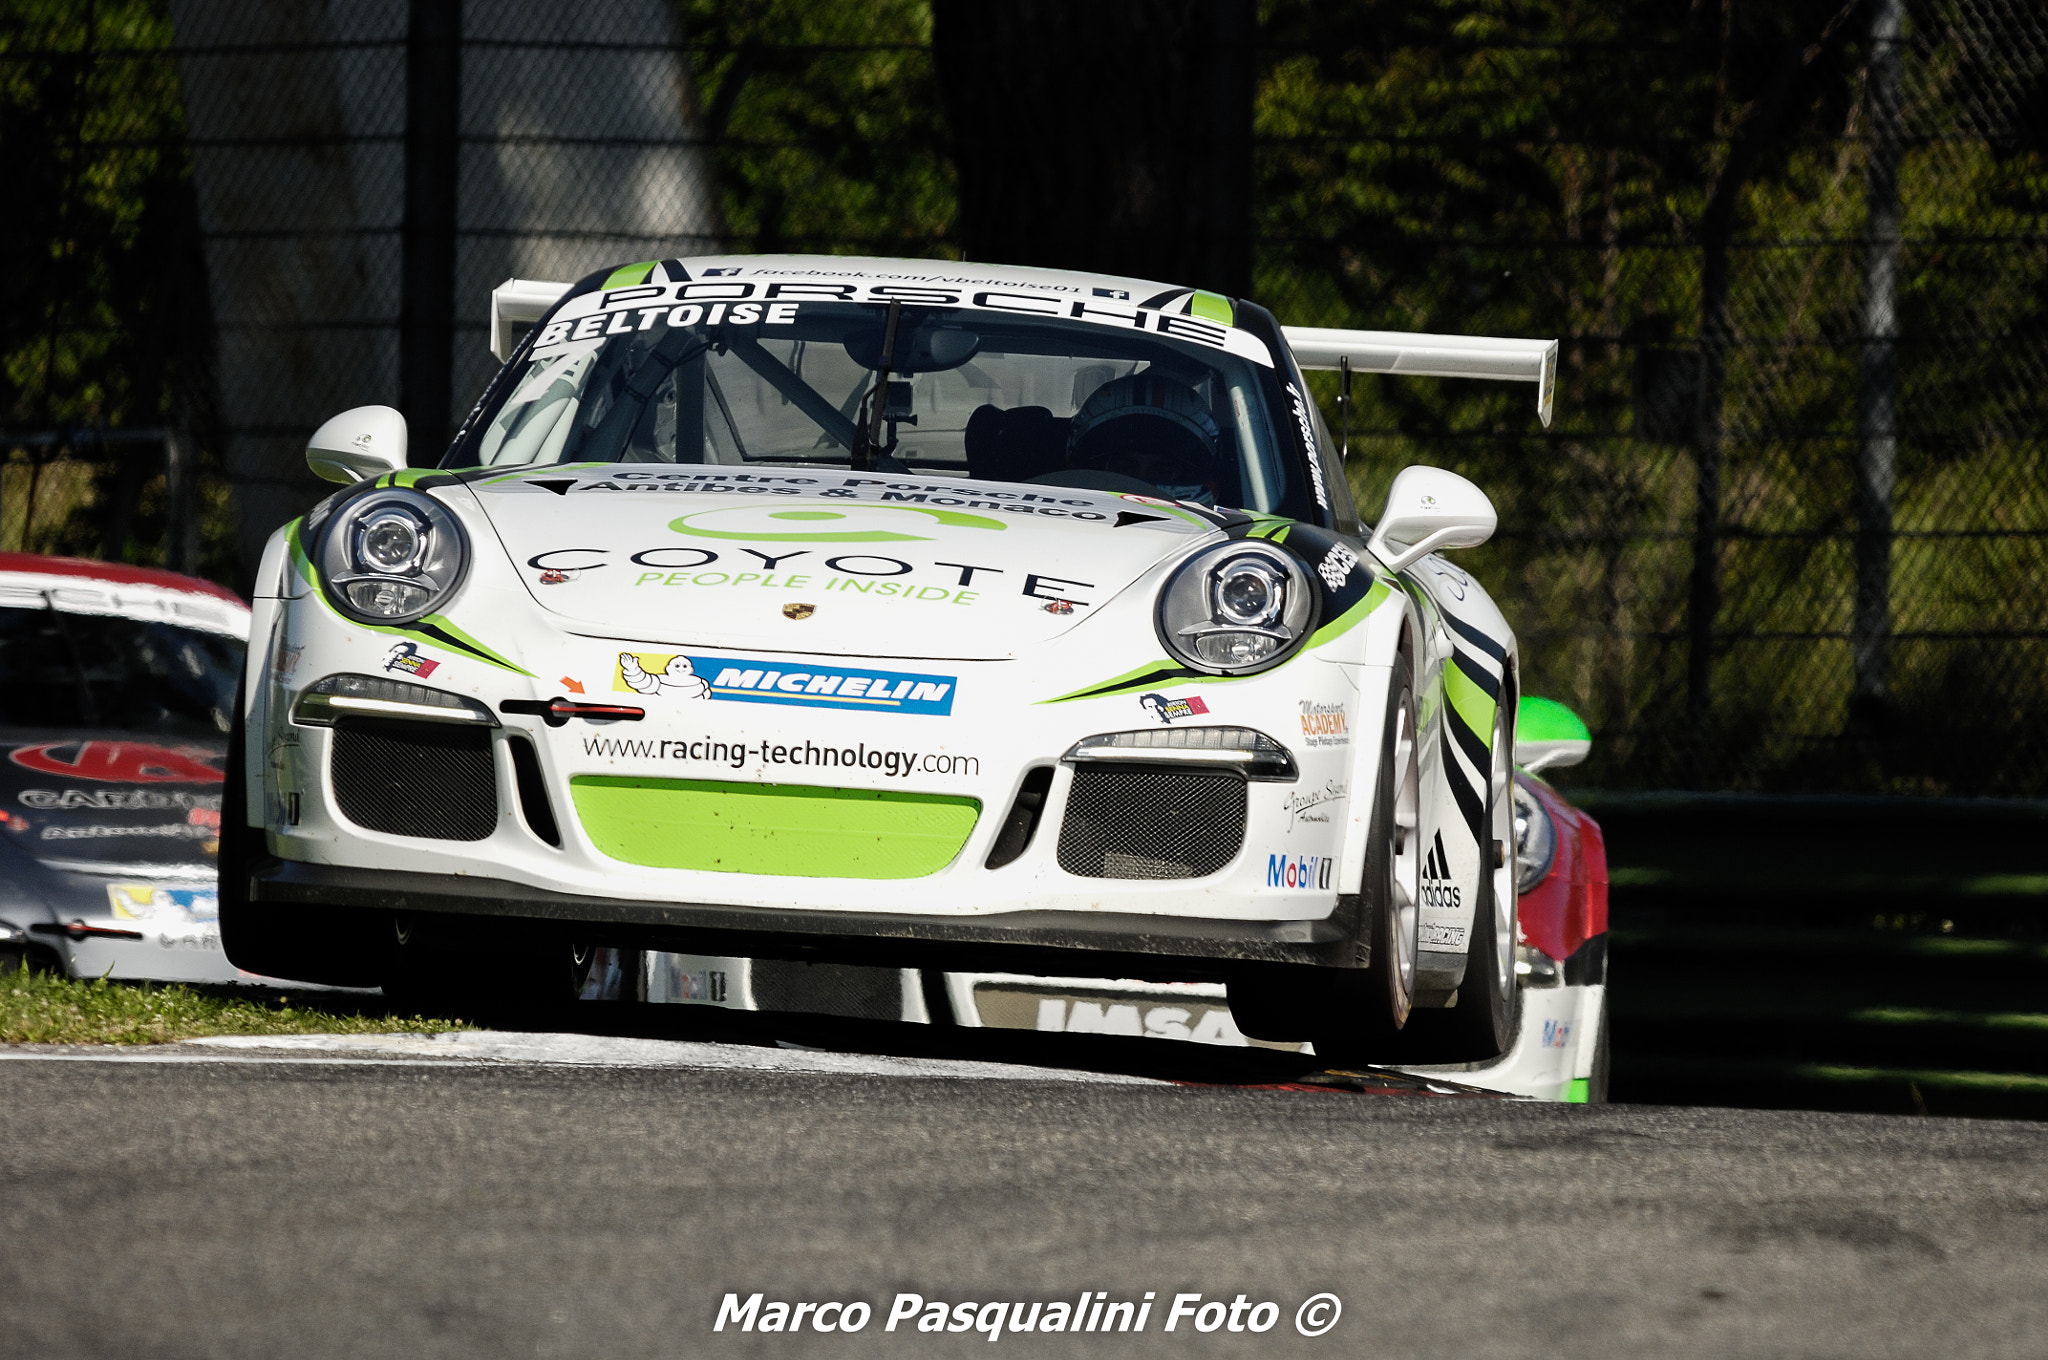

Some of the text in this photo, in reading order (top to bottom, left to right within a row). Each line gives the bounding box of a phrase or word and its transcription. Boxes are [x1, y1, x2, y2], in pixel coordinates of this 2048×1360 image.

[533, 303, 799, 348] BELTOISE
[599, 282, 1227, 348] PORSCHE
[578, 481, 1107, 520] Antibes & Monaco
[612, 472, 1095, 507] Centre Porsche
[527, 546, 1095, 607] COYOTE
[634, 571, 979, 606] PEOPLE INSIDE
[713, 667, 950, 702] MICHELIN
[583, 735, 979, 777] www.racing-technology.com
[1267, 853, 1318, 888] Mobil
[1421, 879, 1461, 908] adidas
[1037, 998, 1249, 1046] IMSA
